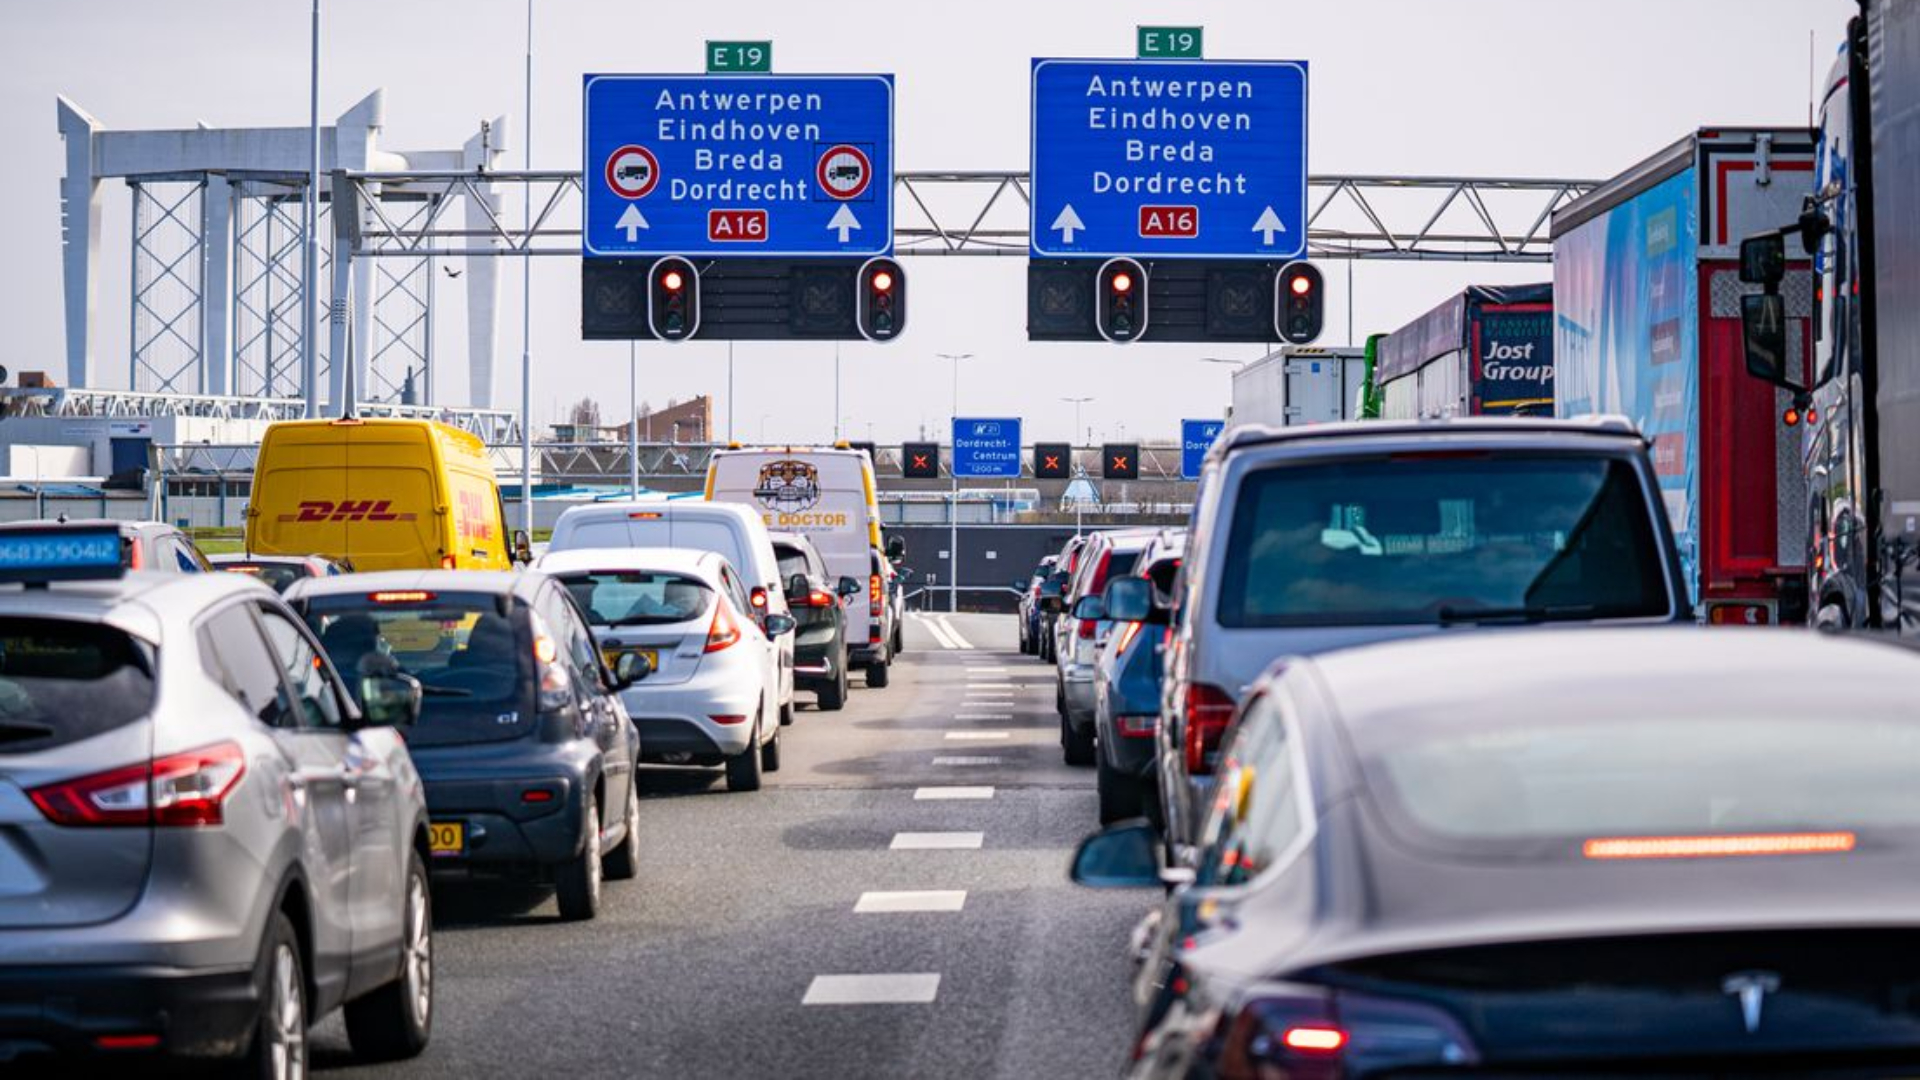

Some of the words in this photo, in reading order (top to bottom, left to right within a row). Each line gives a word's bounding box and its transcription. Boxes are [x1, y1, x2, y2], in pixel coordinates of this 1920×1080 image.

[1145, 32, 1160, 52] E
[1168, 33, 1193, 52] 19
[713, 47, 728, 66] E
[736, 47, 763, 66] 19
[1086, 75, 1253, 102] Antwerpen
[655, 89, 822, 114] Antwerpen
[658, 118, 820, 141] Eindhoven
[1089, 107, 1251, 130] Eindhoven
[695, 148, 783, 171] Breda
[1126, 139, 1214, 162] Breda
[671, 178, 807, 201] Dordrecht
[1093, 171, 1247, 194] Dordrecht
[714, 215, 762, 235] A16
[1145, 211, 1193, 231] A16
[1483, 341, 1535, 360] Jost
[1483, 361, 1554, 385] Group
[973, 451, 1017, 460] Centrum
[297, 500, 397, 522] DHL
[778, 513, 846, 526] DOCTOR
